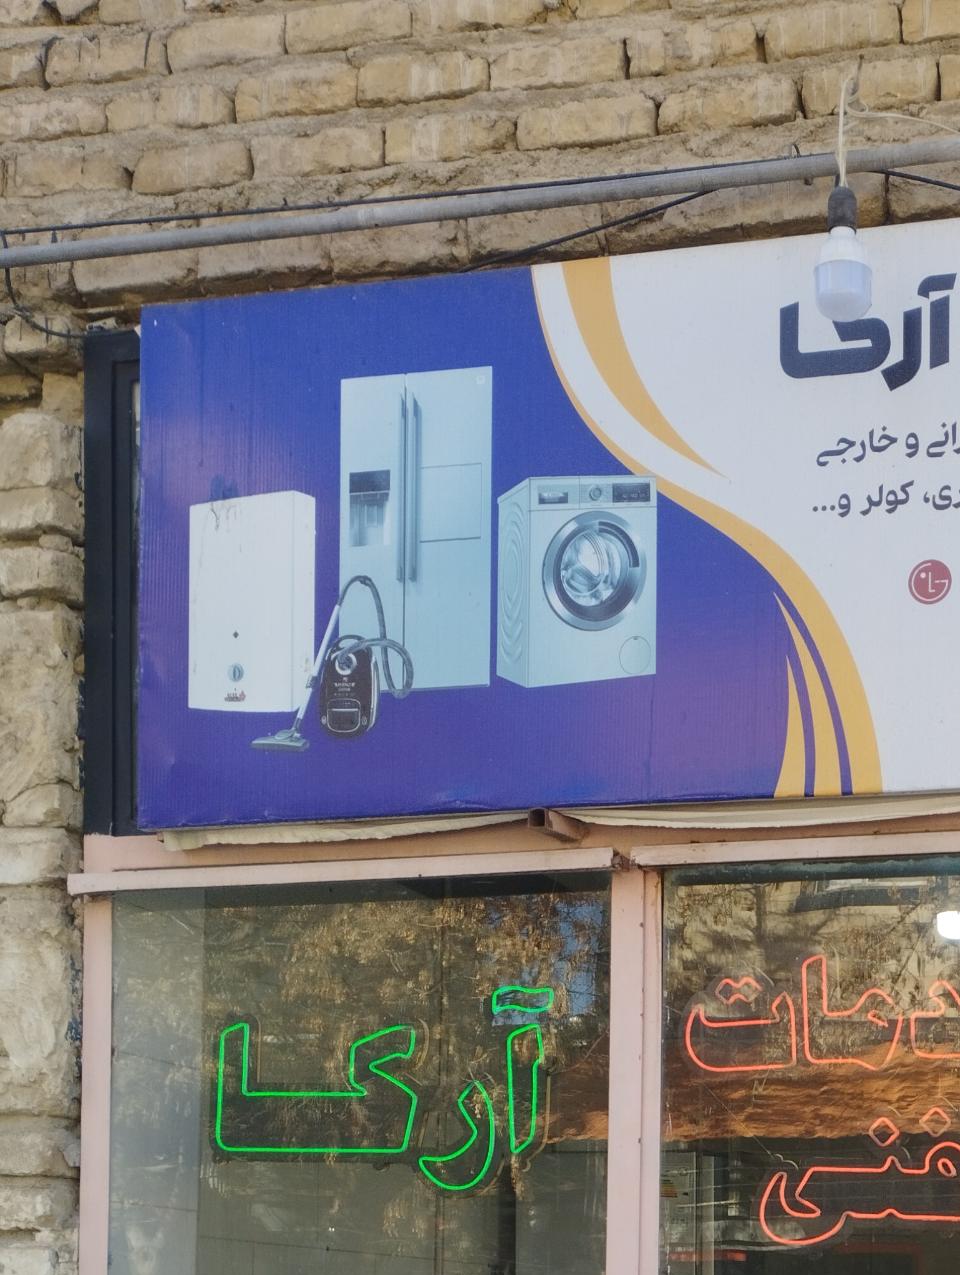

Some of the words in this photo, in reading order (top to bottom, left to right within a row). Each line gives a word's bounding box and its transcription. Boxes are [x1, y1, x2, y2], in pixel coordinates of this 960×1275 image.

[816, 425, 898, 467] خارجی
[905, 431, 919, 457] و
[859, 479, 914, 516] کولر
[215, 986, 554, 1190] آرکا
